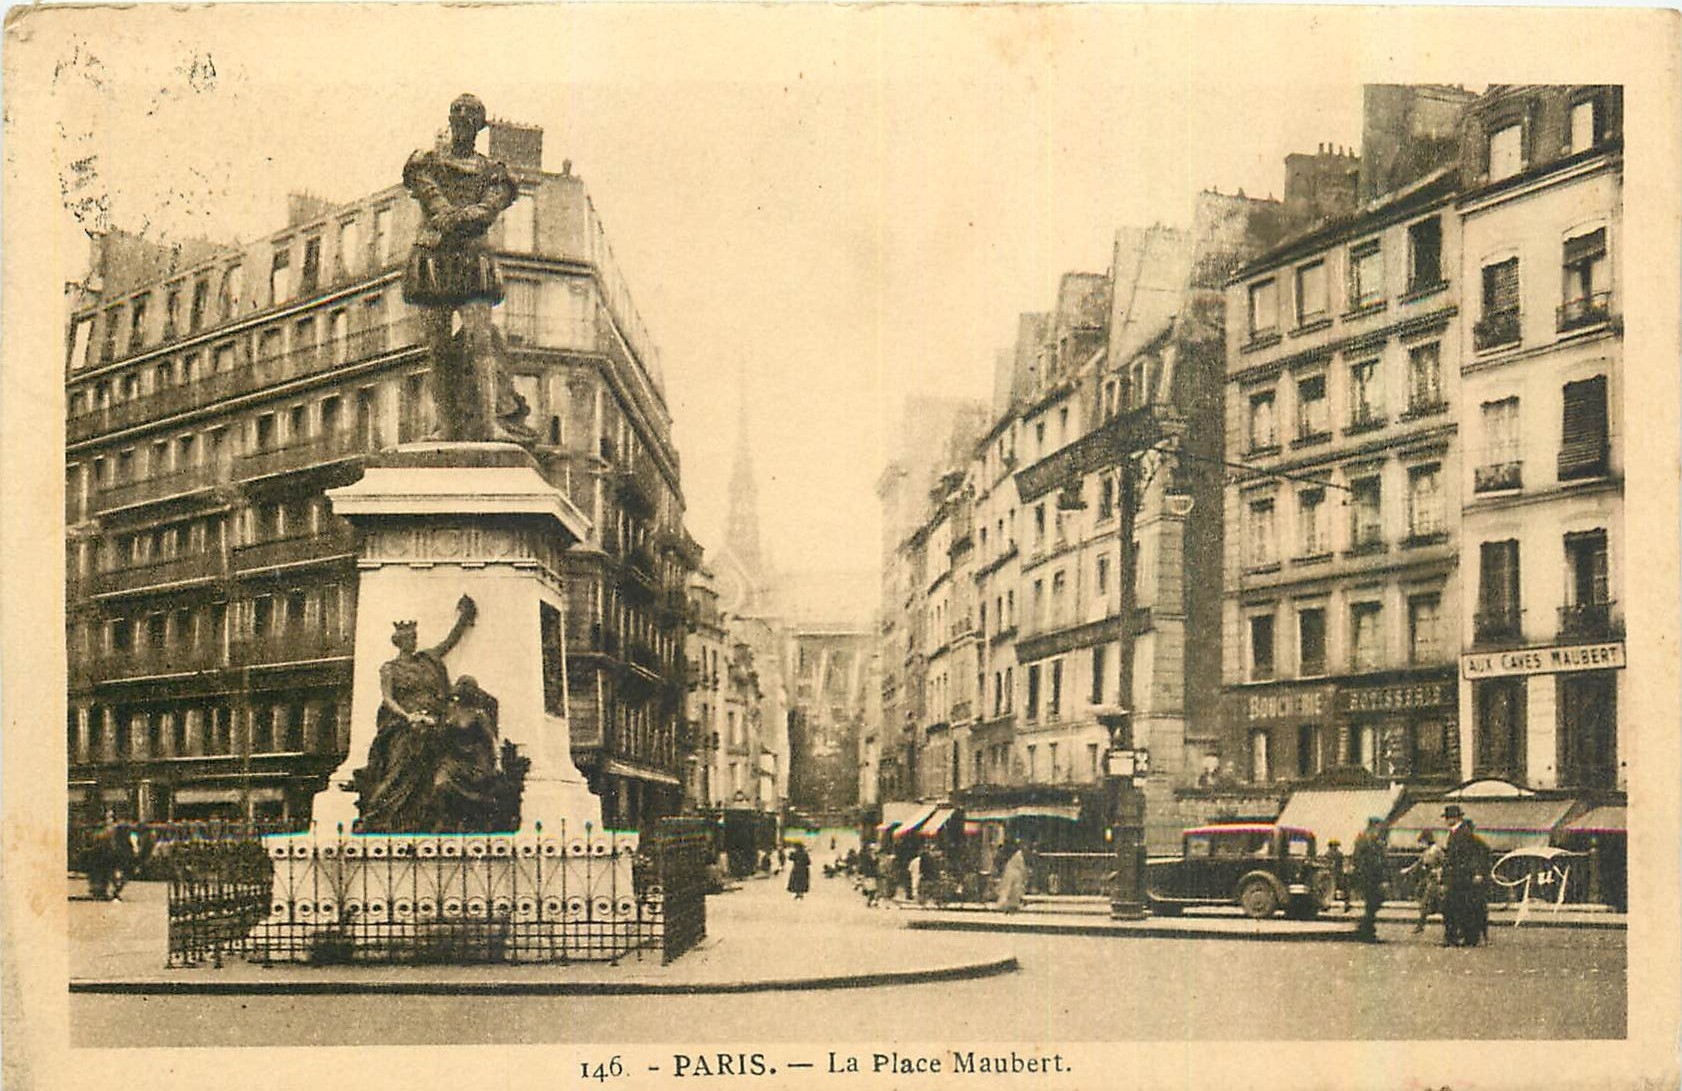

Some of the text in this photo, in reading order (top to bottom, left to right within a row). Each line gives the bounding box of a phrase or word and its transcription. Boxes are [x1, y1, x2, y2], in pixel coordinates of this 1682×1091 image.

[1469, 646, 1618, 673] AUX CAVES MAUBERT
